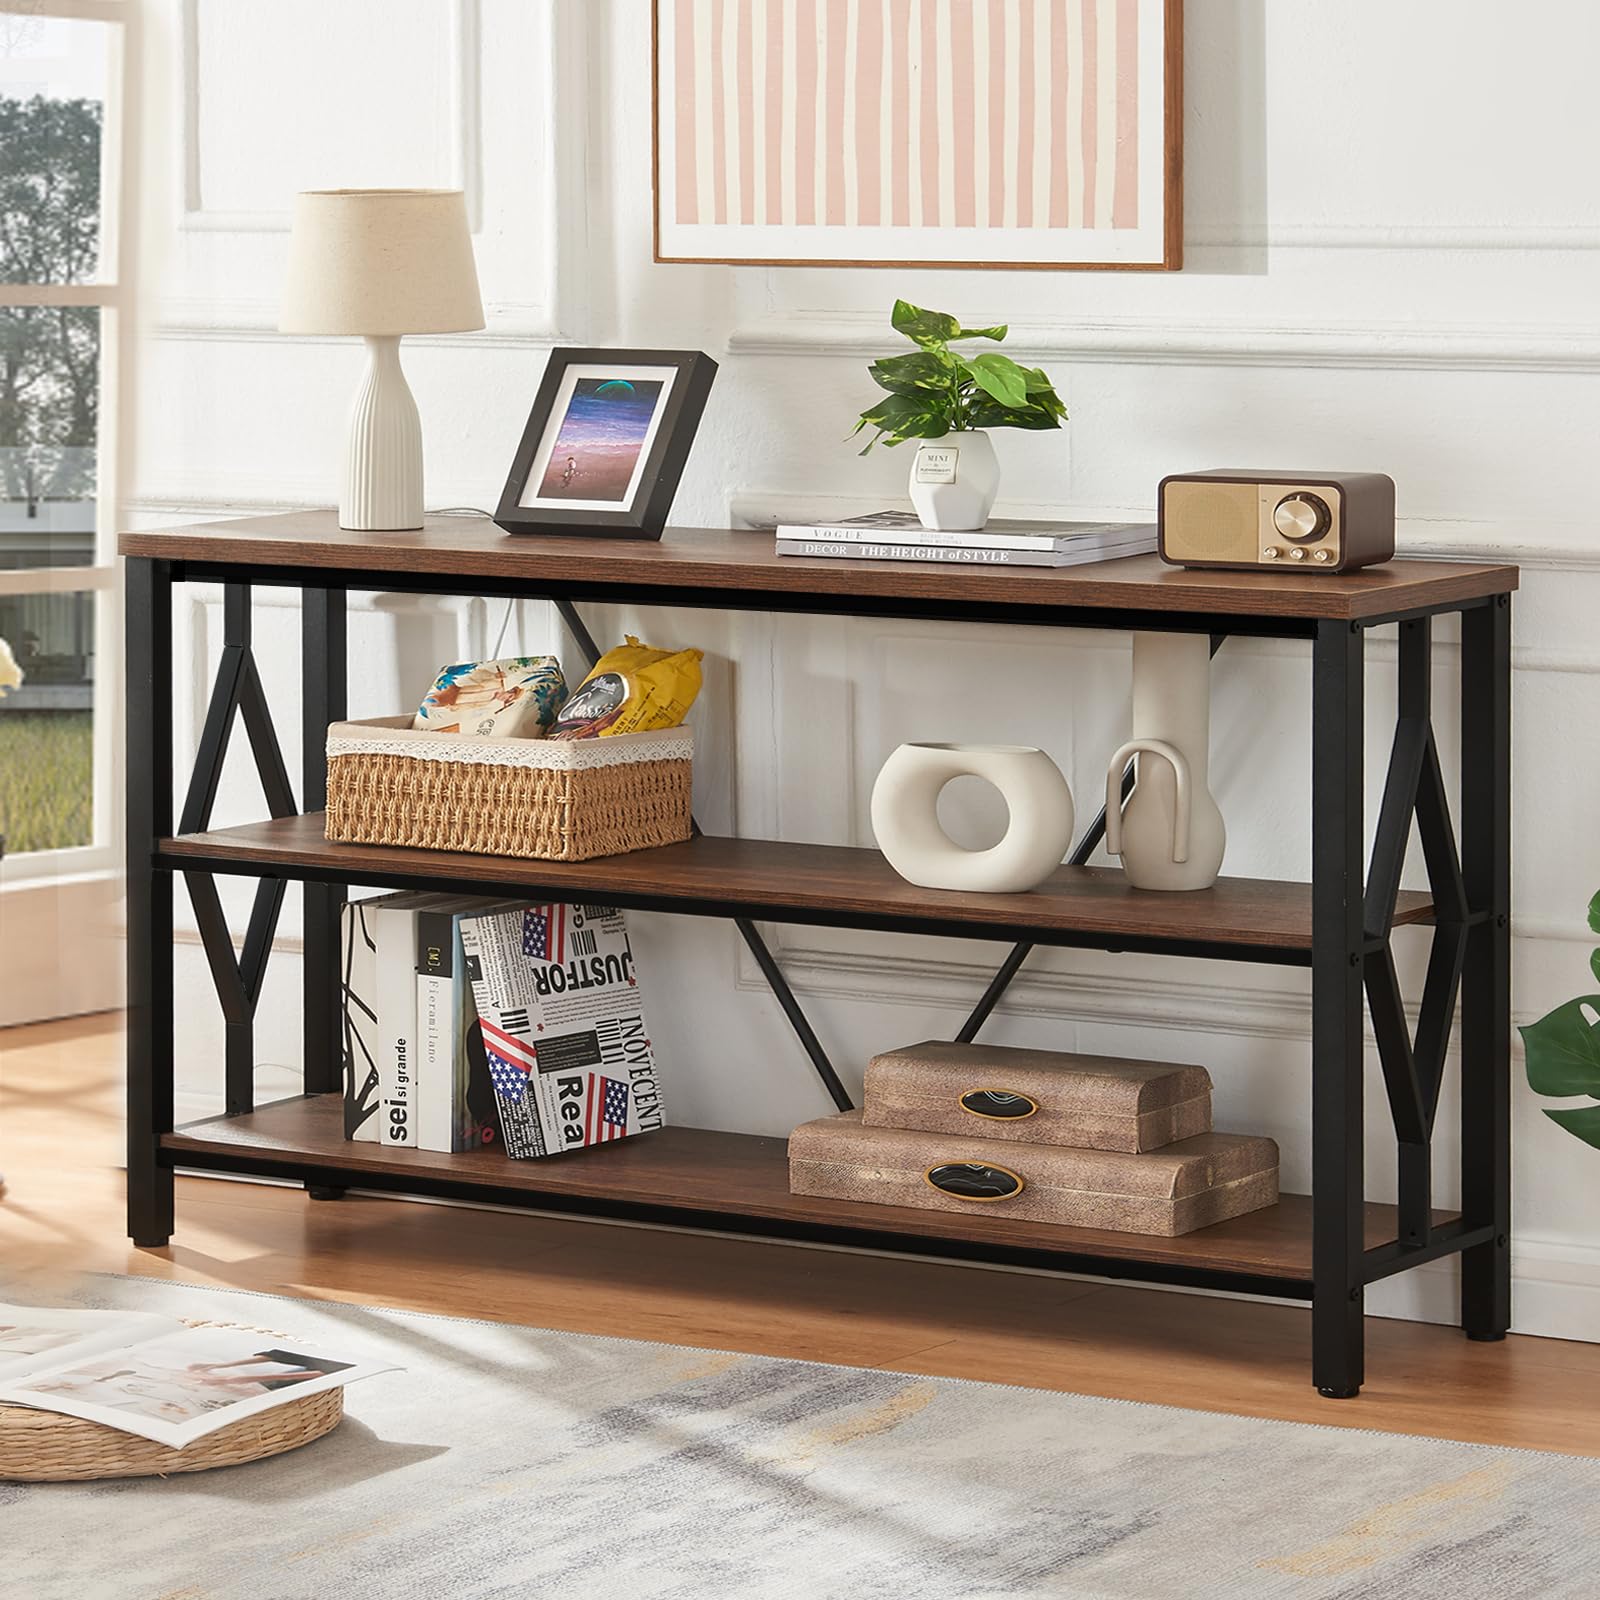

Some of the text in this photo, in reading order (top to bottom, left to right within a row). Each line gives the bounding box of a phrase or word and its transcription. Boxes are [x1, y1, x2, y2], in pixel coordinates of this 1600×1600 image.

[927, 454, 949, 462] MINI
[804, 543, 1010, 562] DECOR THE HEIGHT of STYLE
[812, 528, 865, 540] VOGUE
[530, 951, 634, 996] JUSTFOR
[427, 980, 440, 1064] Fieramilano
[384, 1037, 410, 1142] sei si grande
[617, 1014, 664, 1132] INOVECENT
[556, 1075, 585, 1145] Rea
